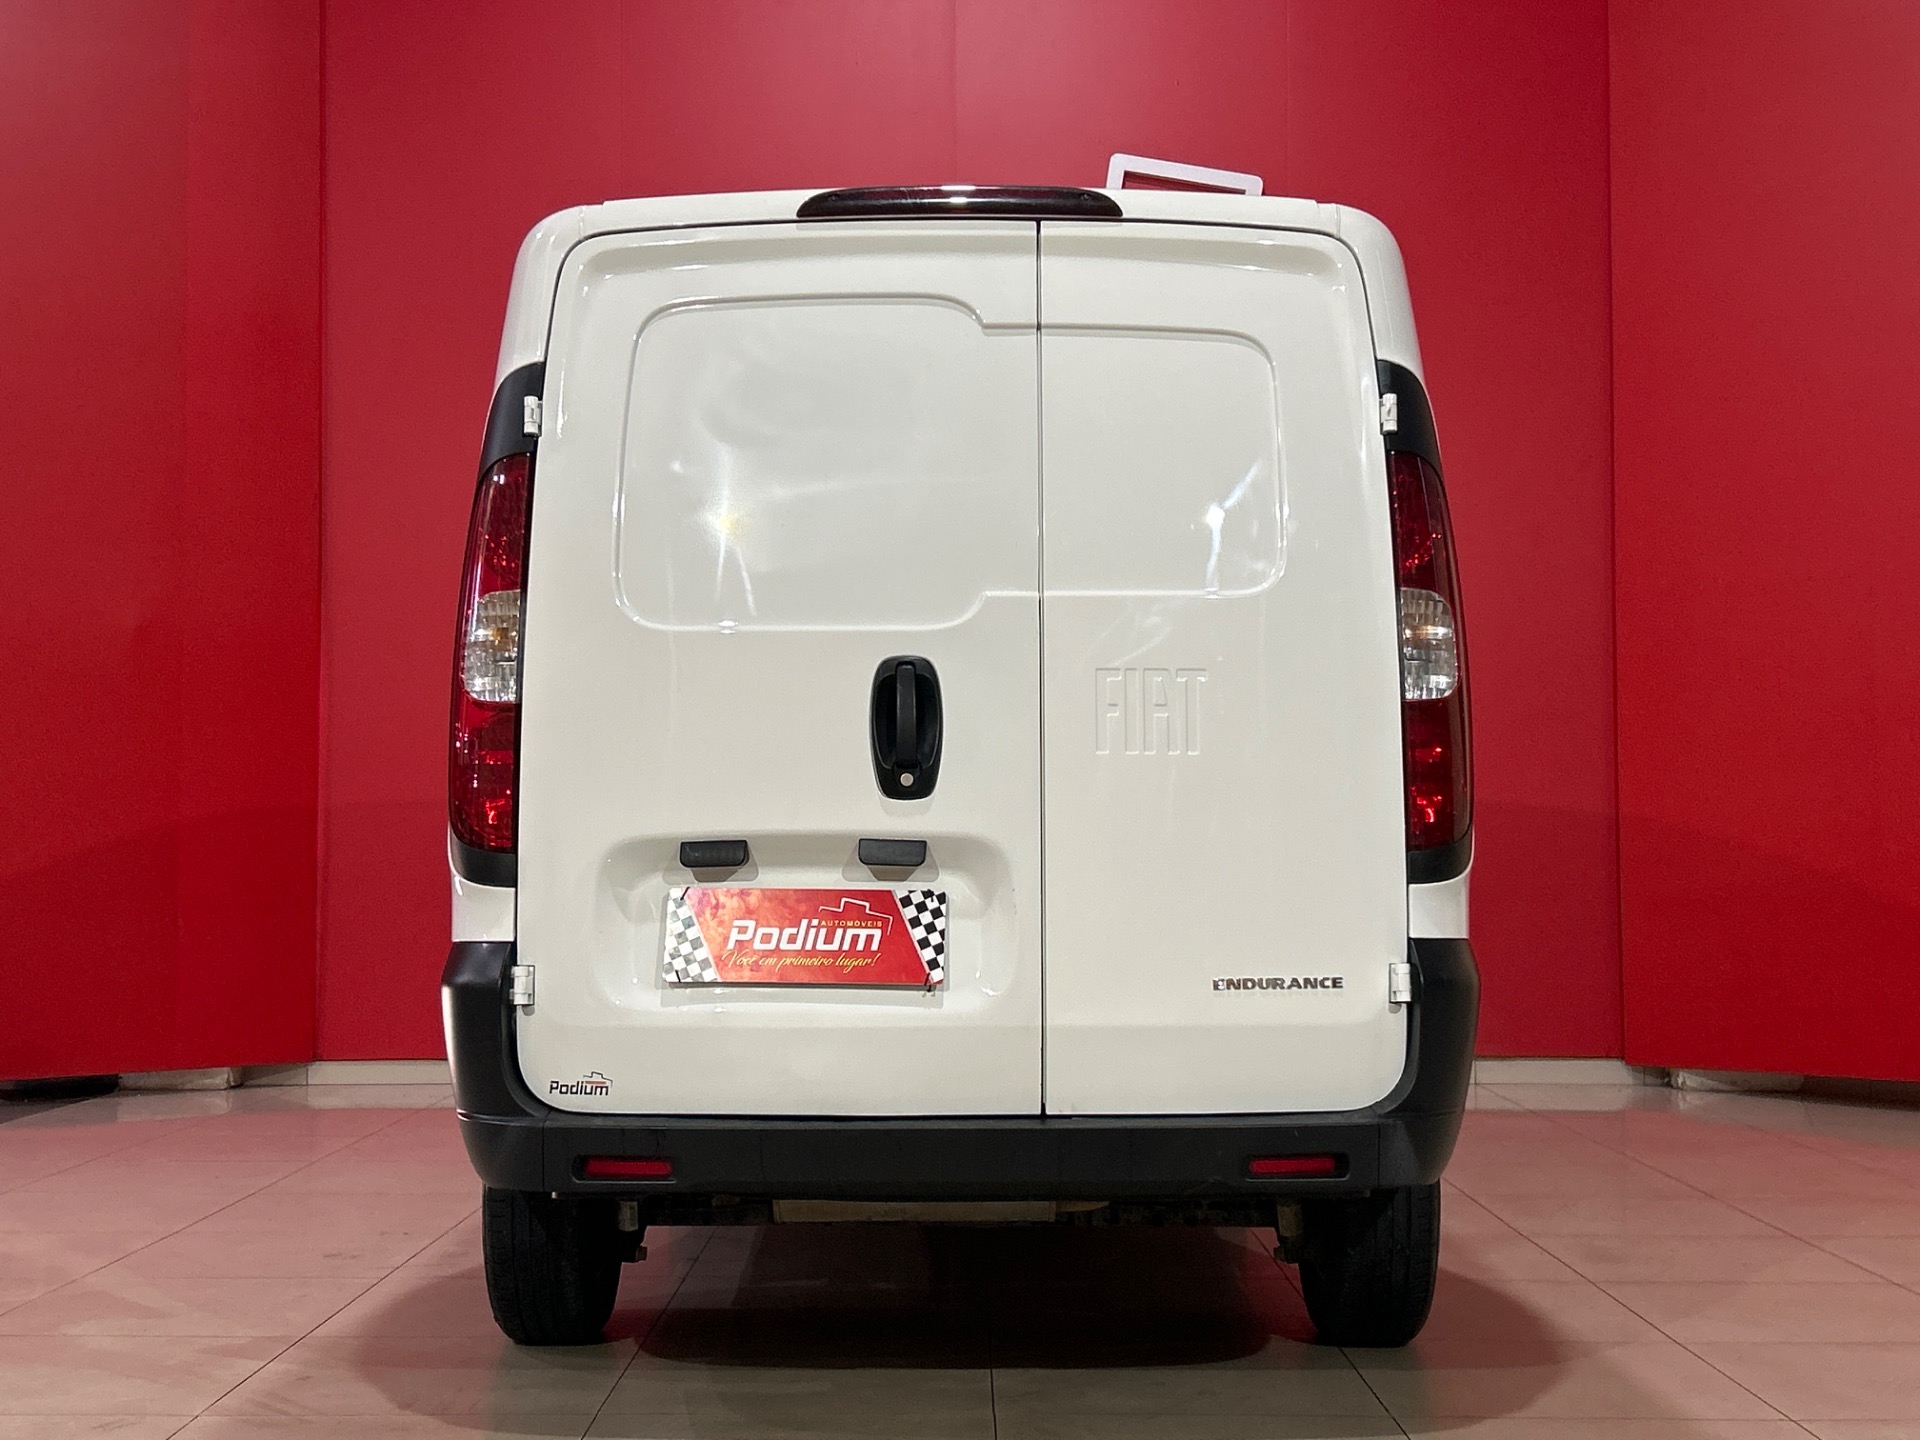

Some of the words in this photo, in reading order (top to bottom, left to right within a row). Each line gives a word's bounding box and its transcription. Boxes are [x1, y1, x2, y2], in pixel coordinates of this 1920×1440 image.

[1095, 667, 1208, 756] FIAT
[726, 918, 882, 952] Podium
[759, 955, 776, 967] em
[775, 954, 834, 973] primeiro
[835, 952, 882, 974] lugar!
[1212, 976, 1344, 991] ENDURANCE
[549, 1080, 609, 1096] Podium
